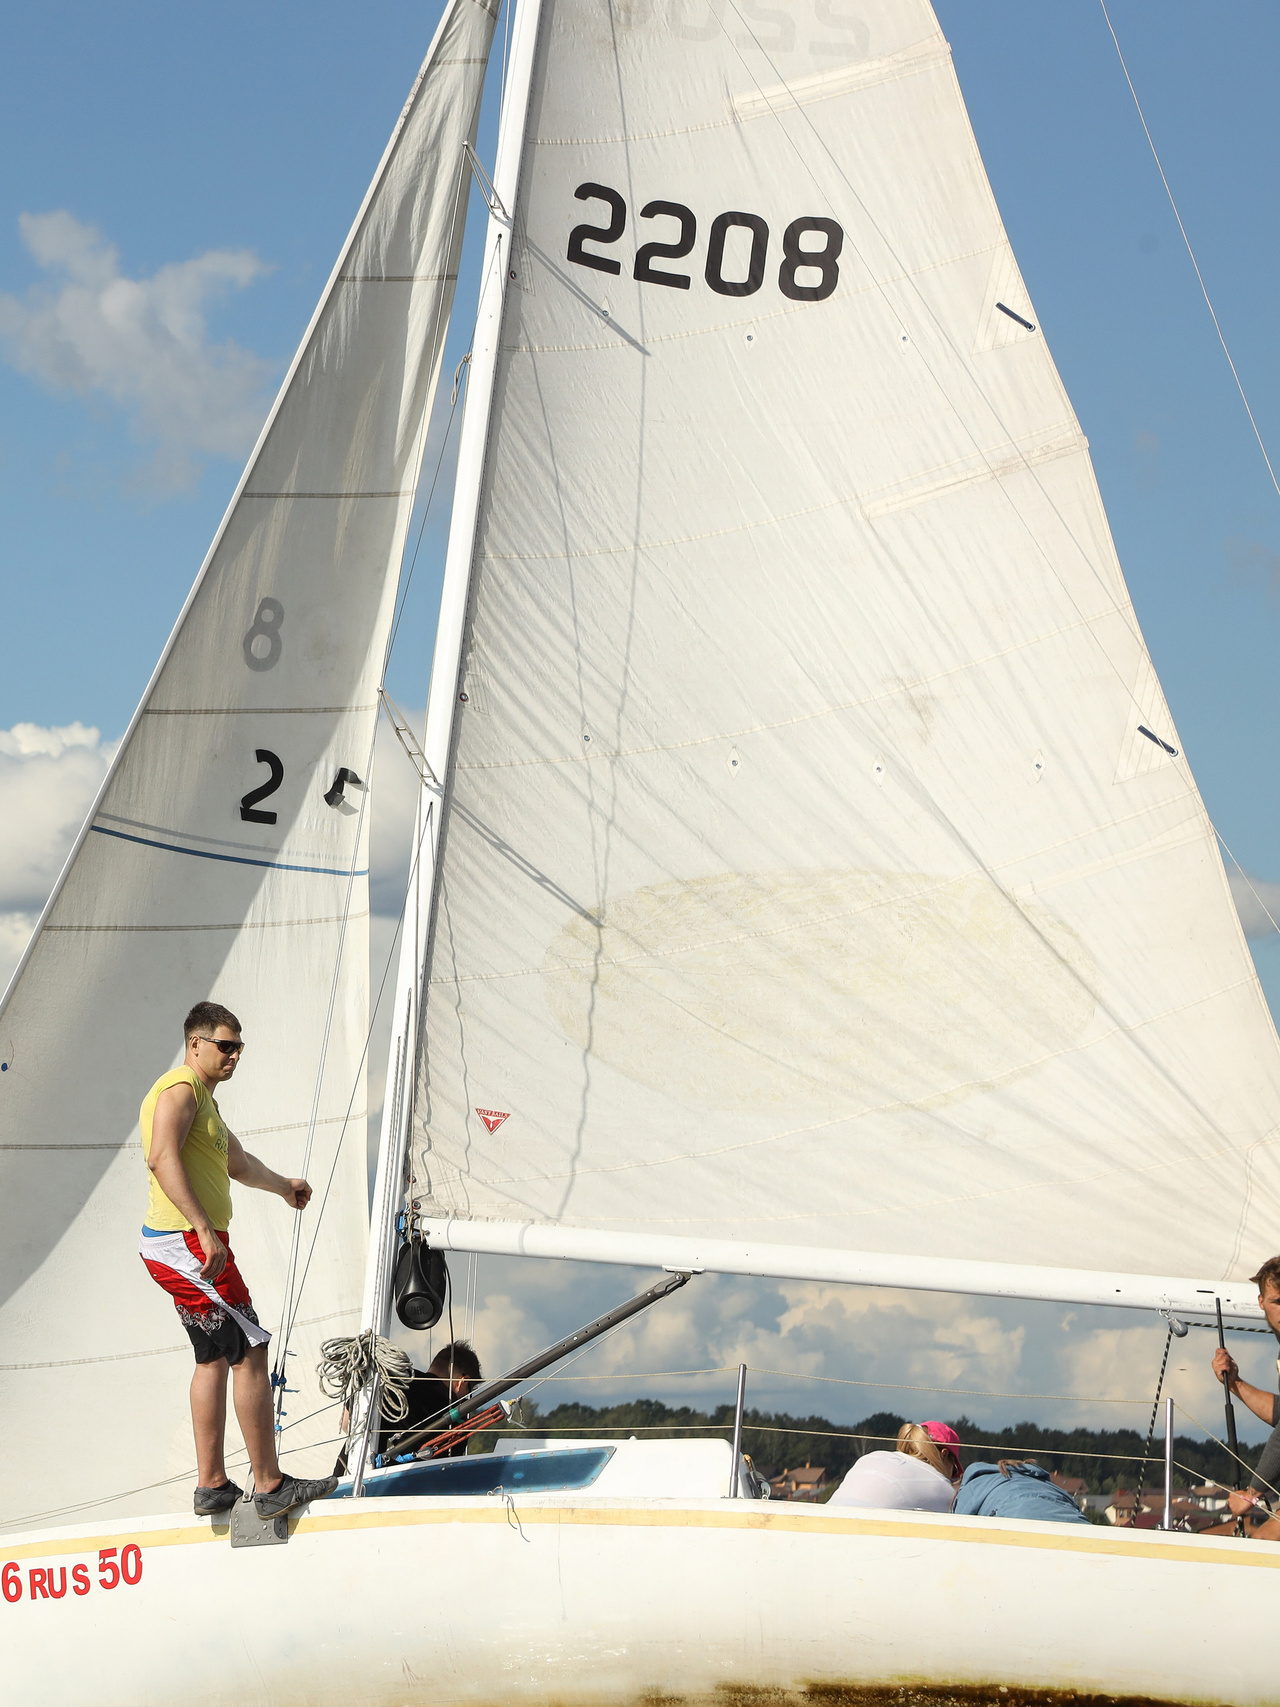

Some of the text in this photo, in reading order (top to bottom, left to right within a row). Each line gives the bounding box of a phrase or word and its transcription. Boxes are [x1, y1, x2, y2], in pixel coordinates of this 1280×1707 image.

[566, 182, 844, 301] 2208
[242, 597, 285, 672] 8
[240, 749, 284, 825] 2
[99, 1544, 143, 1589] 50
